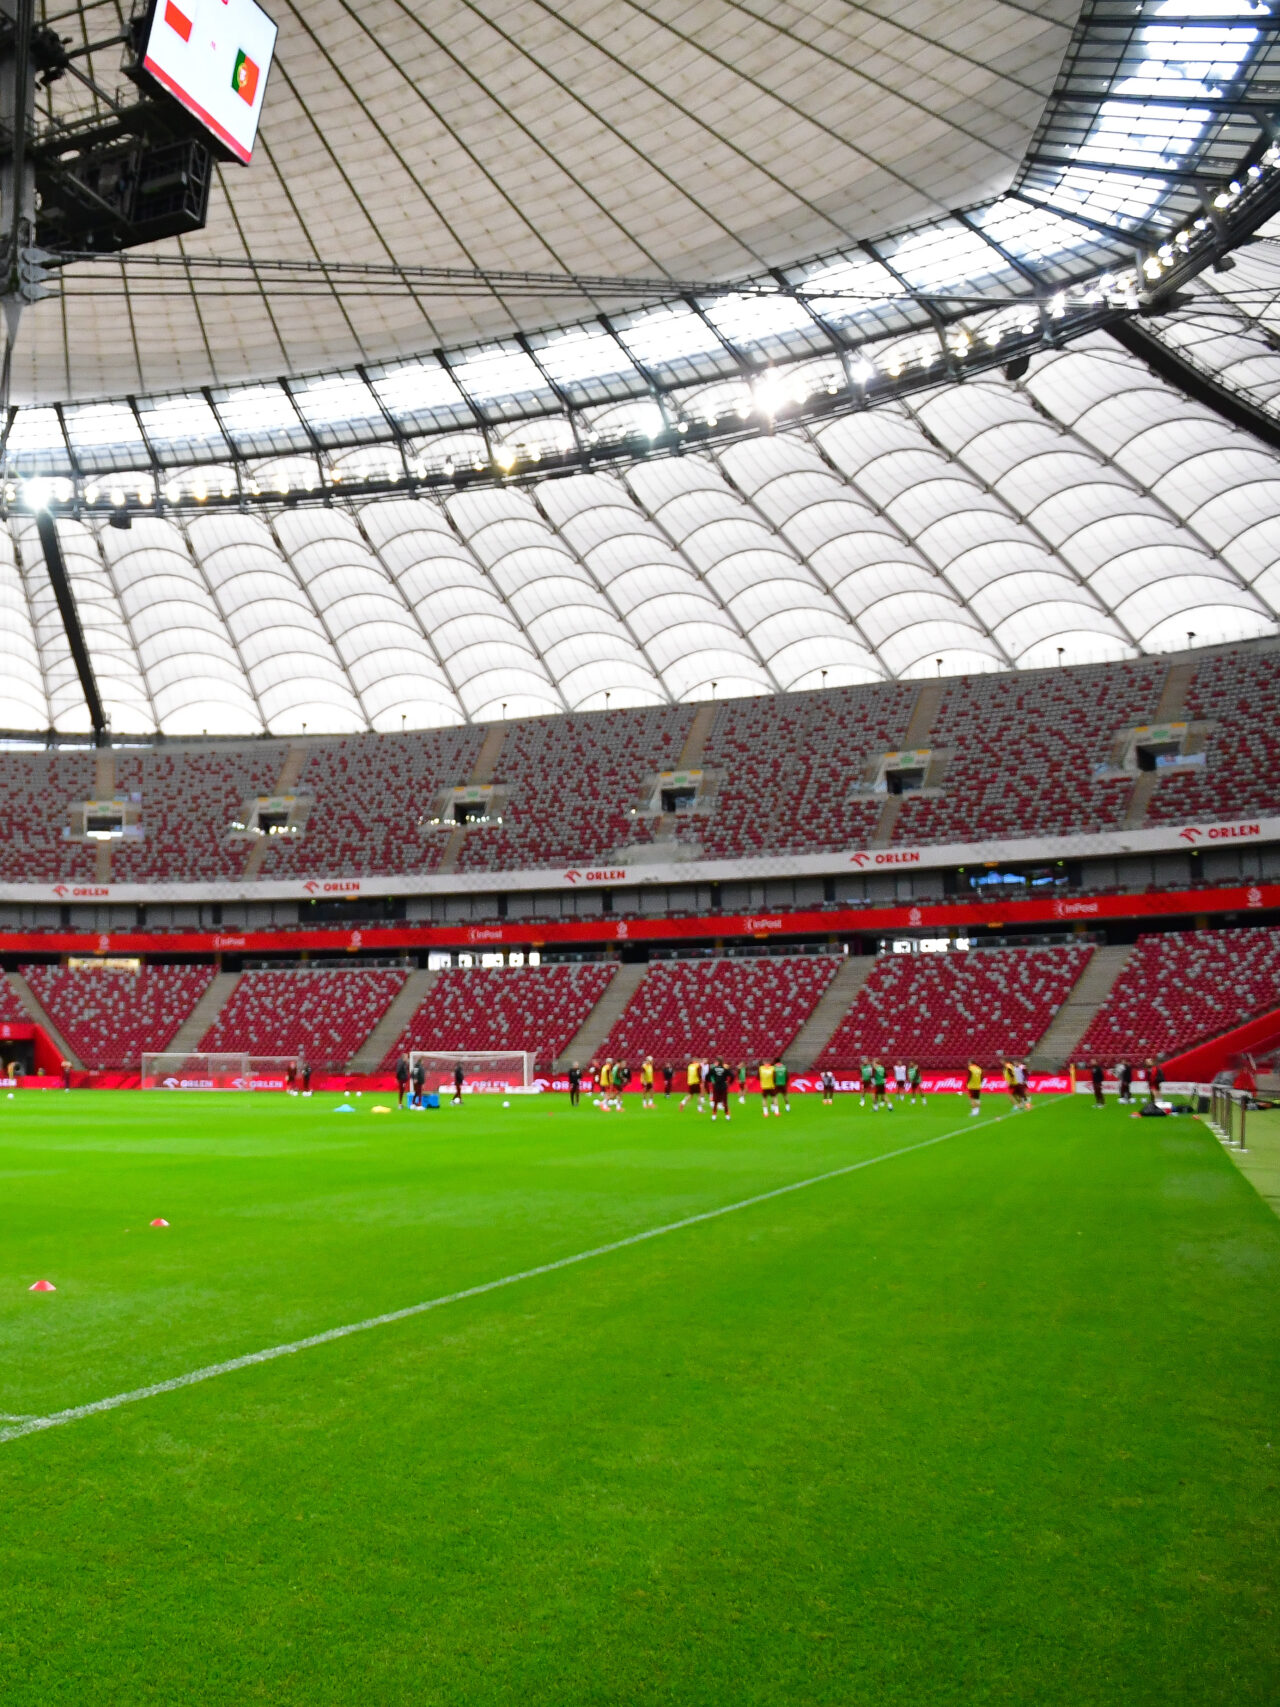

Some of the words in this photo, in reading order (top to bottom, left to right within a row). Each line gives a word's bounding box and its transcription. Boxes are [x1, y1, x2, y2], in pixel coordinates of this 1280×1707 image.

[1208, 825, 1261, 839] ORLEN
[875, 851, 920, 865] ORLEN
[586, 870, 626, 882] ORLEN
[72, 886, 110, 897] ORLEN
[324, 881, 360, 892] ORLEN
[1065, 902, 1098, 914] InPost
[180, 1079, 214, 1088] ORLEN
[249, 1080, 284, 1088] ORLEN
[814, 1080, 861, 1091] OLEN
